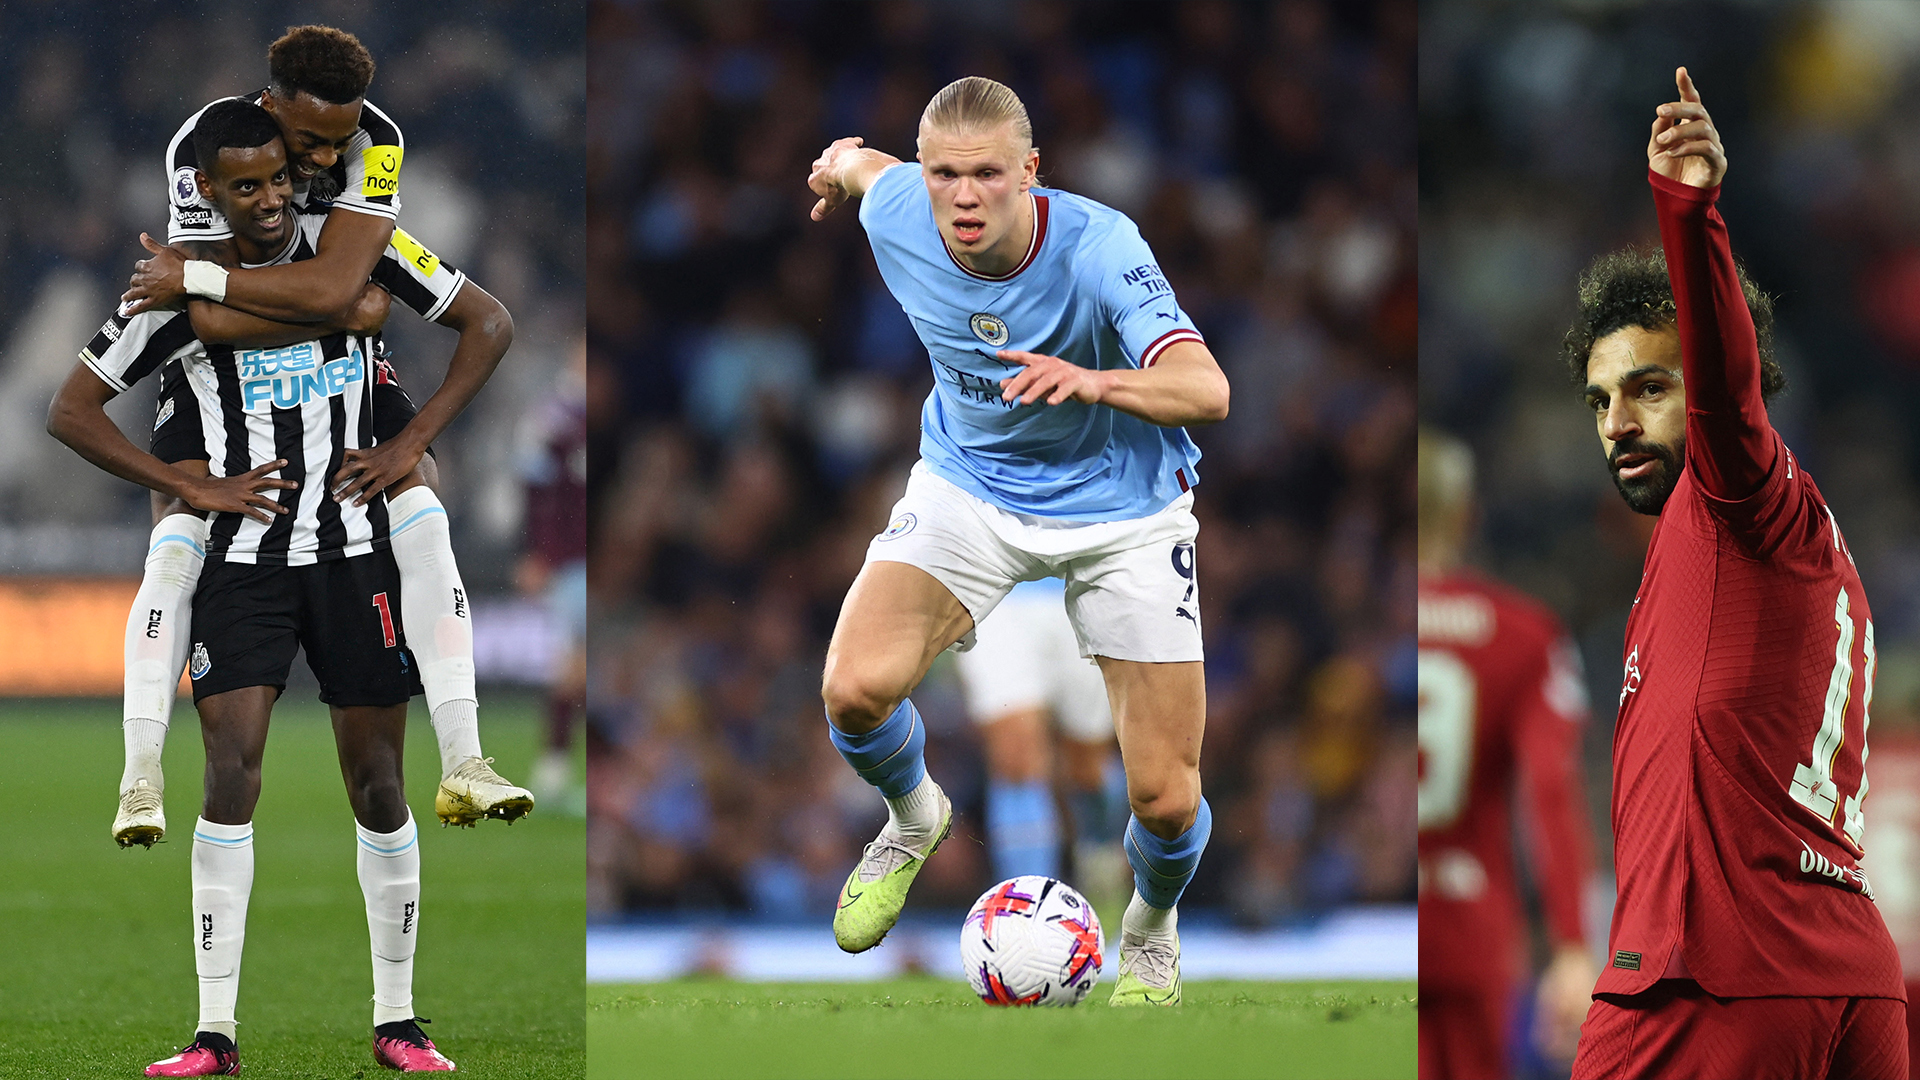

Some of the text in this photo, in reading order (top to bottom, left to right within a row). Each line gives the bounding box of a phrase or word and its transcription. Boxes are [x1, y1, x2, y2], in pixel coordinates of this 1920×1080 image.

[241, 344, 317, 378] 乐天堂
[244, 348, 364, 411] FUN88
[1171, 543, 1194, 602] 9
[453, 587, 466, 619] NUFC
[146, 608, 163, 639] NUFC
[1788, 585, 1876, 849] 11
[201, 913, 213, 951] NUFC
[403, 901, 415, 934] NUFC
